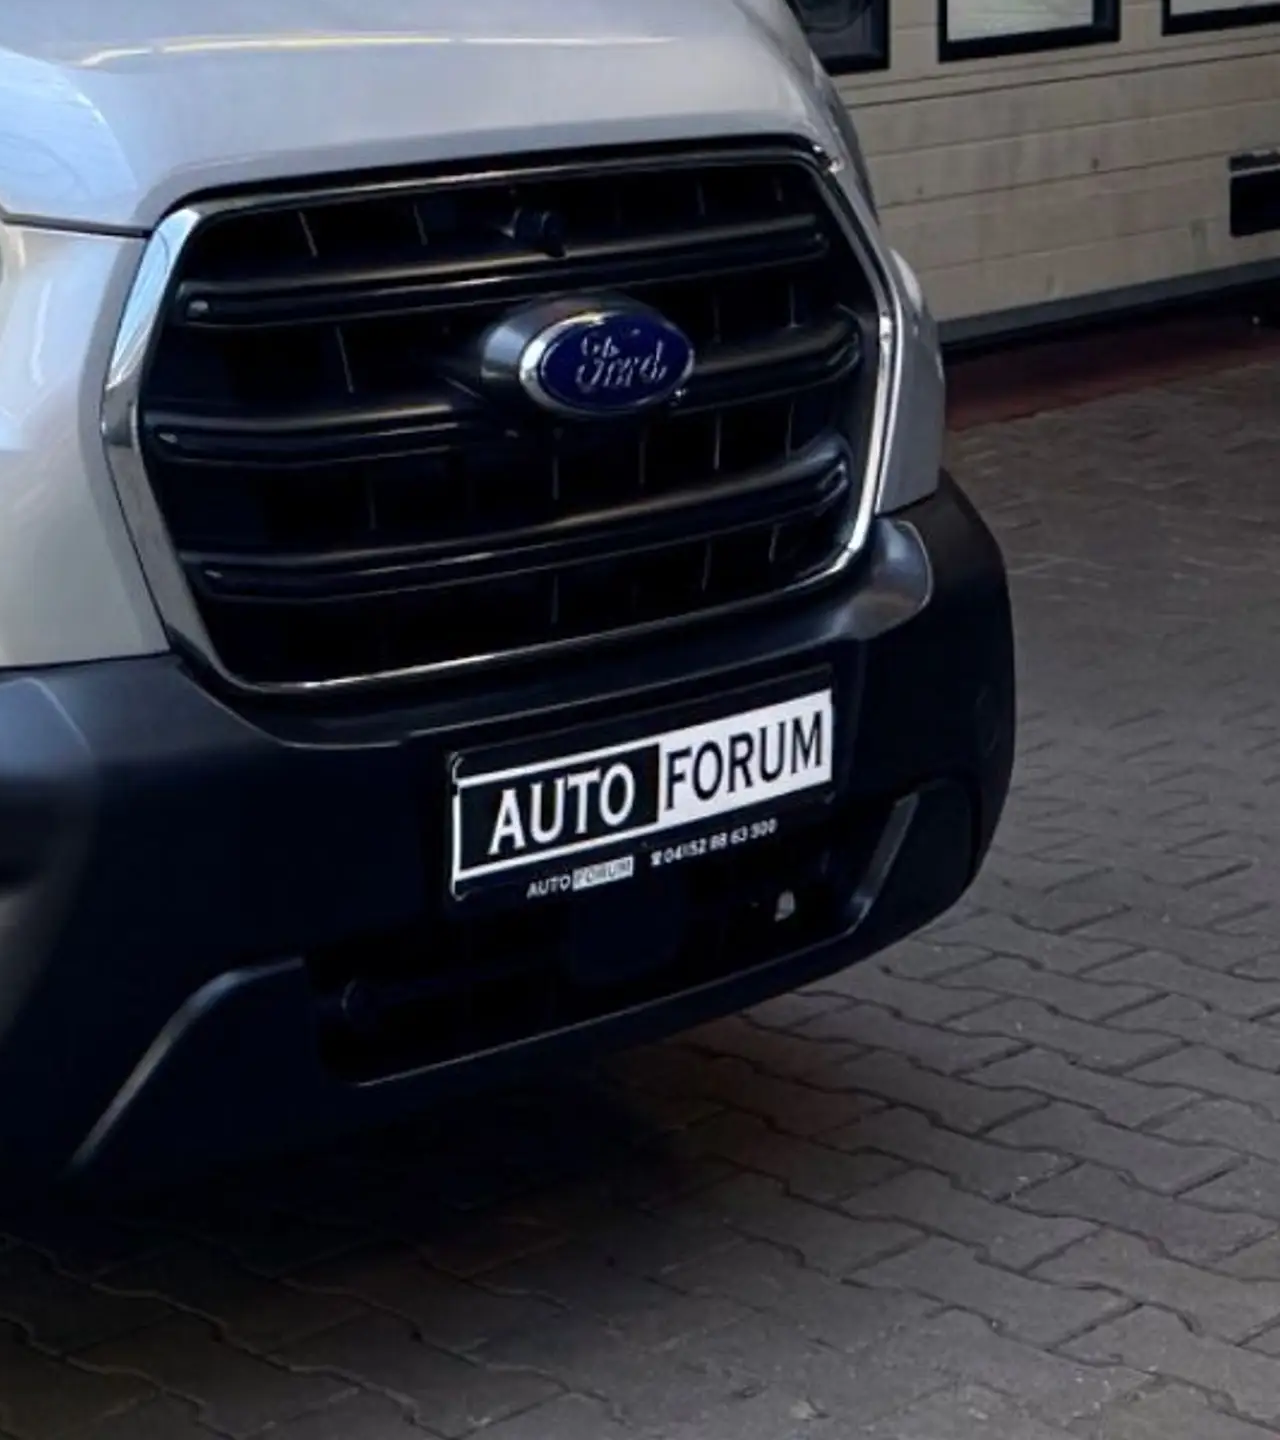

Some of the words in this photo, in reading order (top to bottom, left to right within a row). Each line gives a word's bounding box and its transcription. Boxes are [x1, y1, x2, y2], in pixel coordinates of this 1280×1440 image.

[576, 336, 668, 394] Ford
[487, 761, 636, 856] AUTO
[664, 710, 824, 813] FORUM
[526, 874, 571, 900] AUTO
